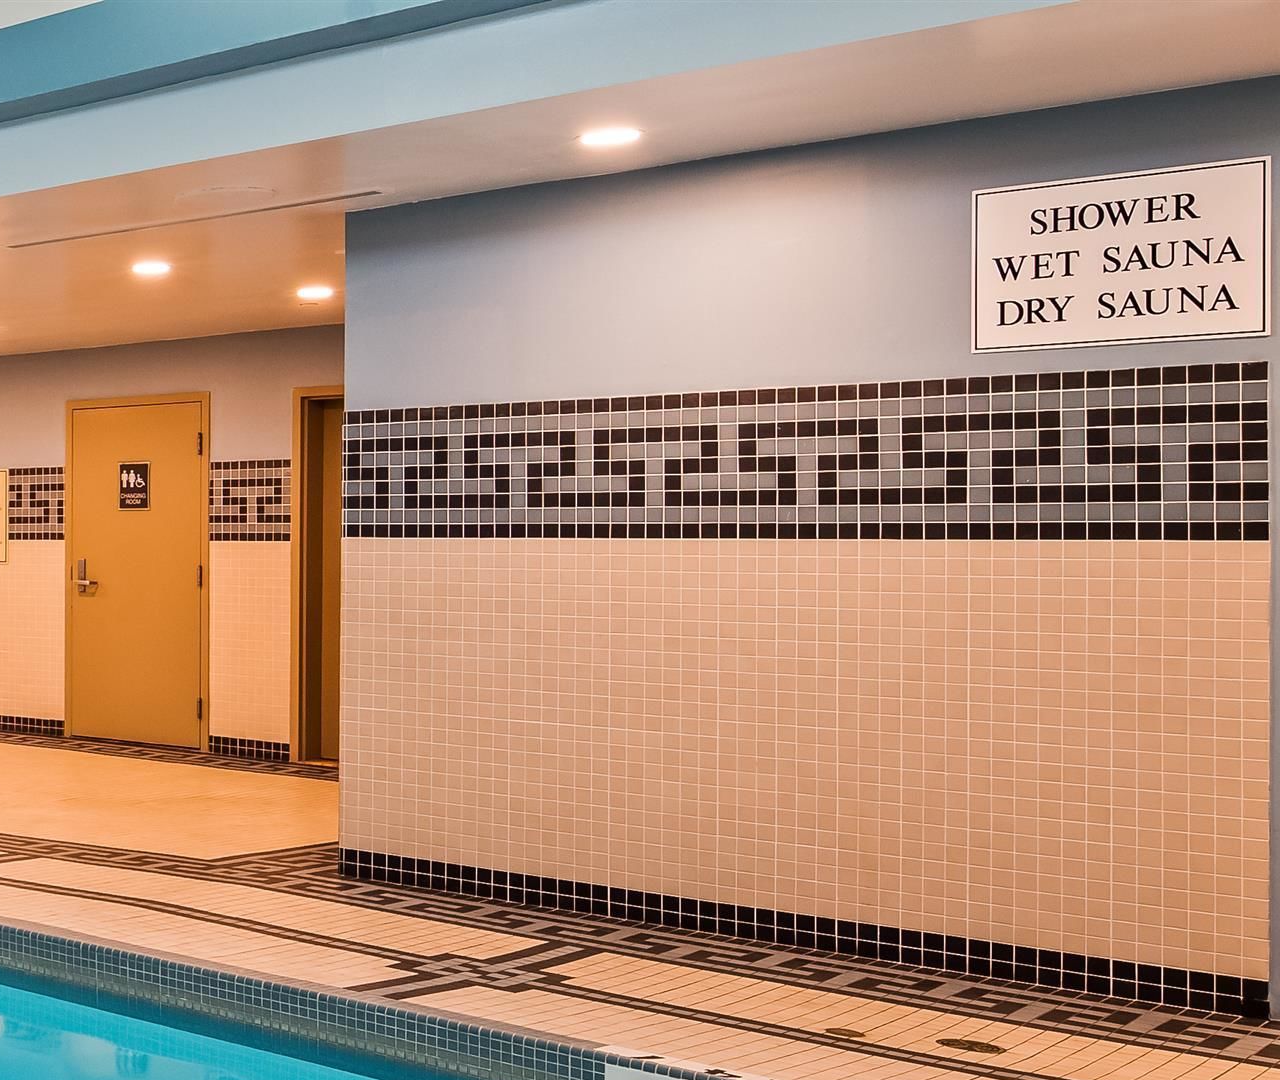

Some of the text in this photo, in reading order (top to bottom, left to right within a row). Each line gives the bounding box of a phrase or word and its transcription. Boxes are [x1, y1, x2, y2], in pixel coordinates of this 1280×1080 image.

[1030, 193, 1200, 235] SHOWER
[992, 236, 1245, 282] WET SAUNA
[997, 284, 1240, 326] DRY SAUNA
